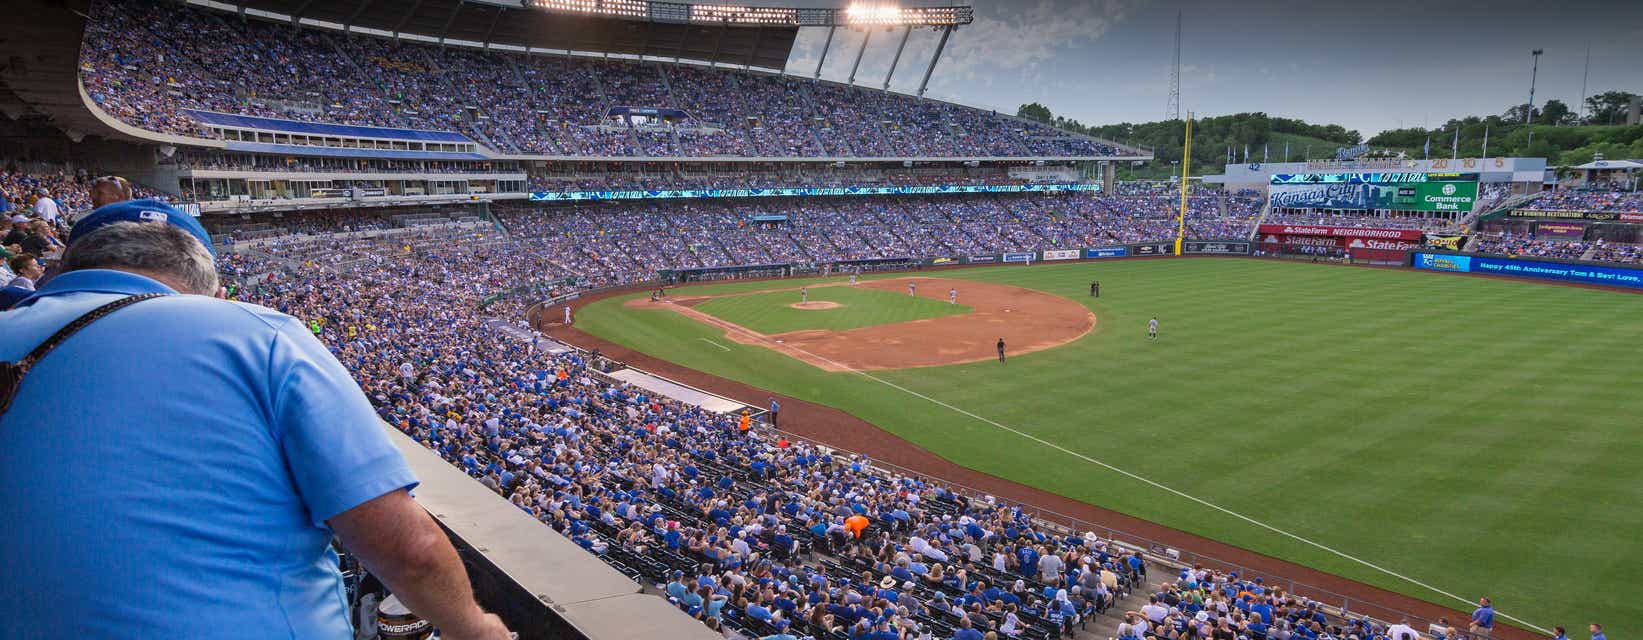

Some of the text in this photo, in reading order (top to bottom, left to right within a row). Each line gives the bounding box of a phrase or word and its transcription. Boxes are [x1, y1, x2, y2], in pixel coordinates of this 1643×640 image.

[1249, 163, 1260, 171] 42
[1432, 159, 1448, 168] 20
[1463, 159, 1475, 168] 10
[1495, 157, 1504, 168] 5
[1271, 182, 1356, 207] Kansas City
[1424, 195, 1471, 203] Commerce
[1332, 228, 1402, 238] NEIGHBORHOOD
[1480, 262, 1504, 271] Happy
[1523, 266, 1568, 276] Anniversary
